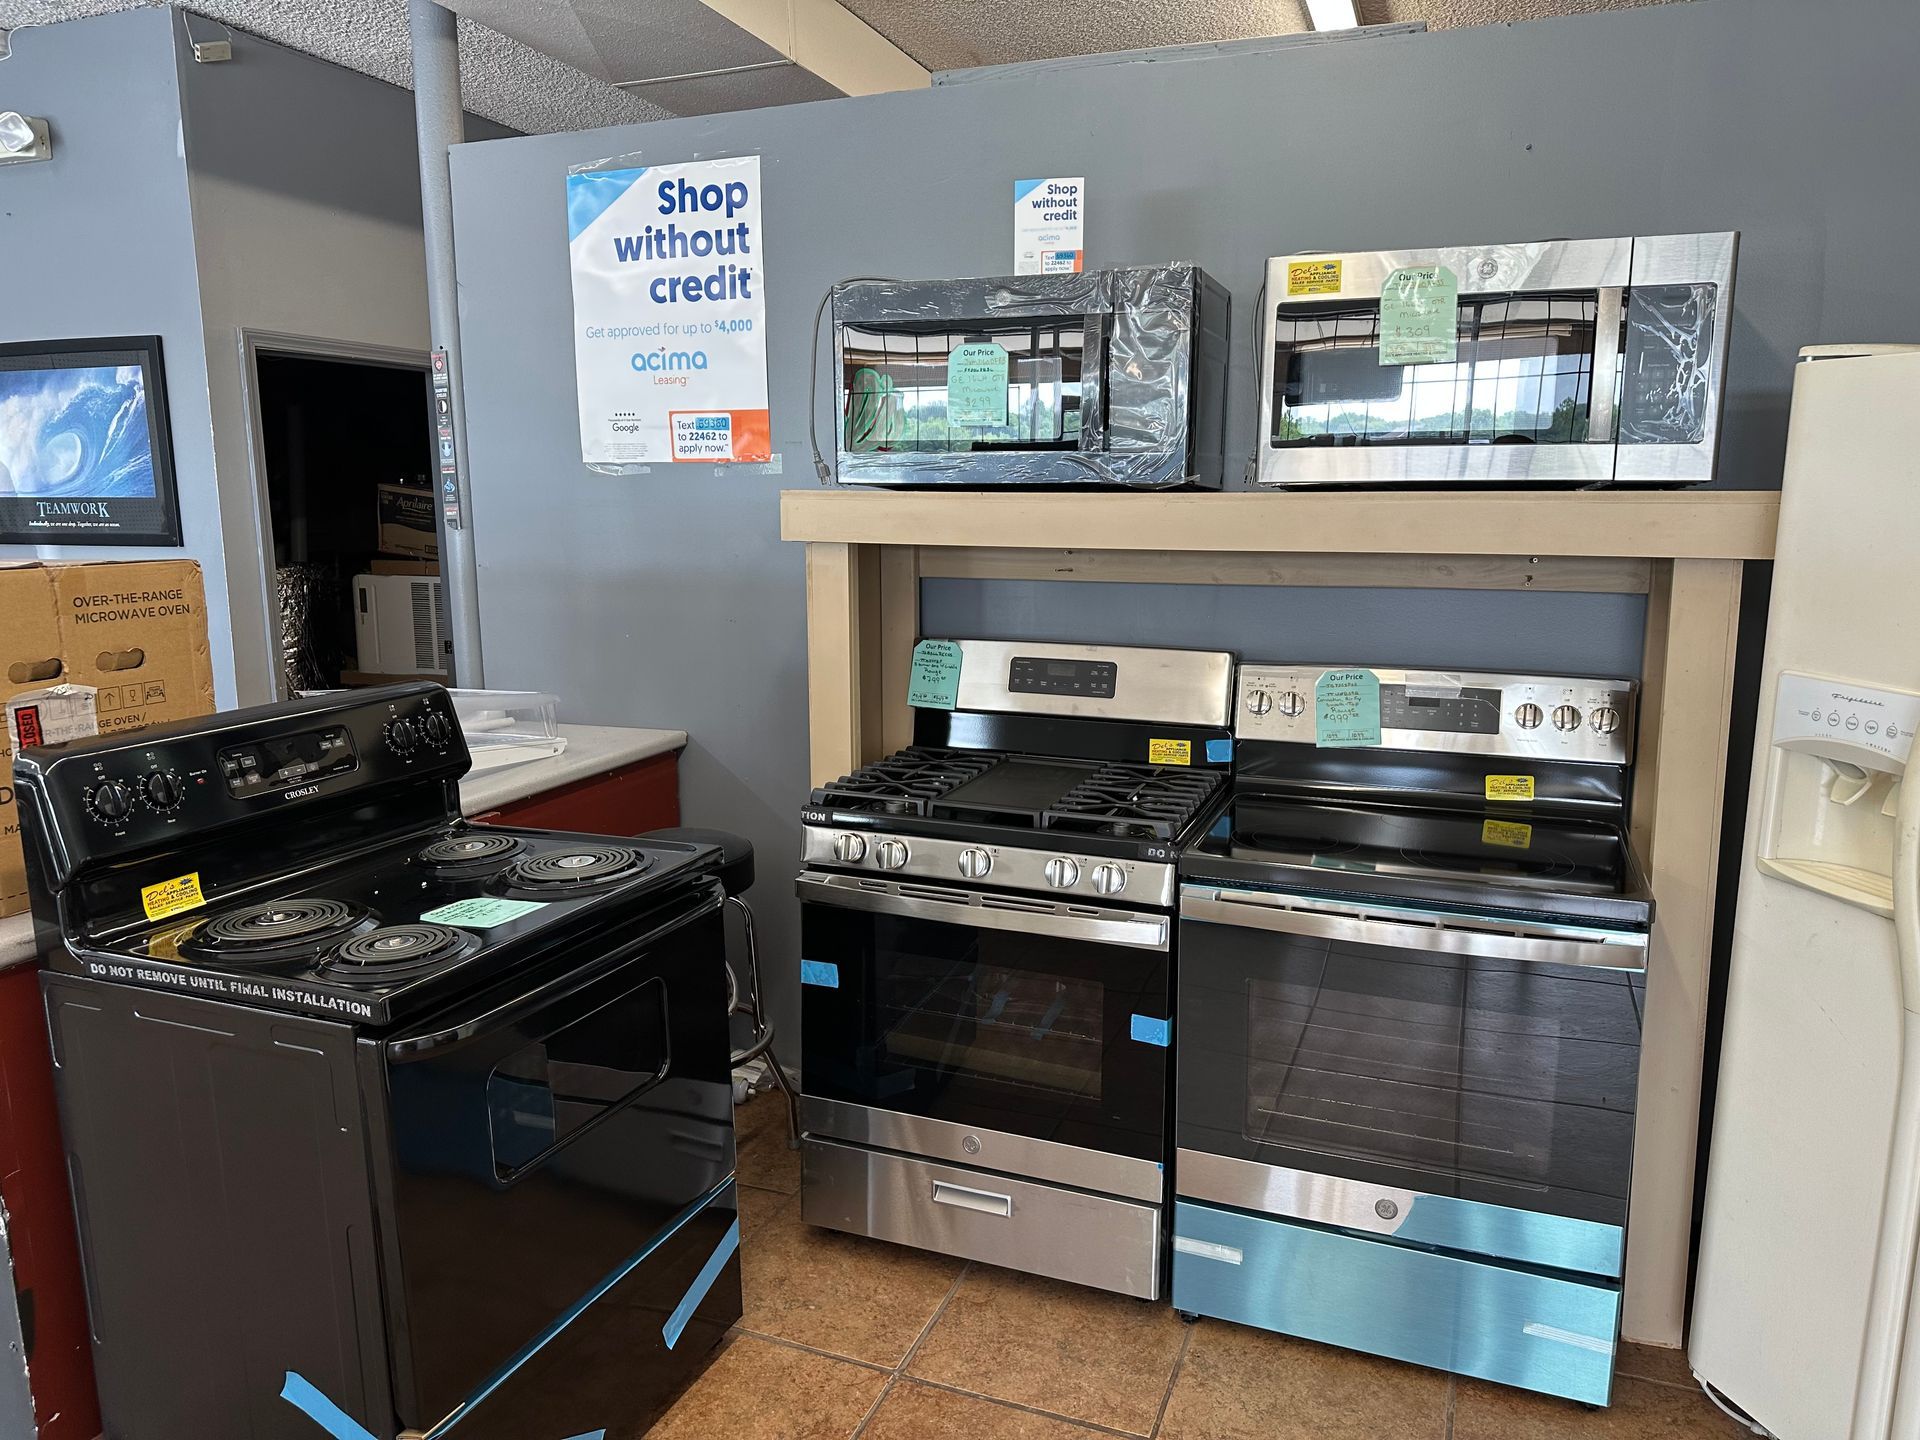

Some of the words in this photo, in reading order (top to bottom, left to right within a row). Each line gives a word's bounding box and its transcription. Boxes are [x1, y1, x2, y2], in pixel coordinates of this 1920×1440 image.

[1047, 184, 1078, 196] Shop
[658, 178, 748, 218] Shop
[1032, 197, 1078, 209] without
[1043, 209, 1078, 221] credit
[614, 222, 750, 262] without
[650, 264, 752, 303] credit
[586, 326, 605, 338] Get
[607, 322, 660, 340] approved
[663, 322, 679, 335] for
[682, 324, 698, 336] up
[700, 322, 712, 333] to
[714, 319, 753, 334] $4,000
[631, 347, 708, 371] acima
[653, 375, 688, 387] Leasing
[612, 423, 639, 433] Google
[677, 421, 695, 429] Text
[678, 433, 687, 441] to
[689, 432, 717, 441] 22462
[719, 433, 728, 441] to
[679, 444, 703, 454] apply
[36, 501, 110, 518] TEAMWORK
[73, 589, 183, 608] OVER-THE-RANGE
[75, 607, 156, 625] MICROWAVE
[158, 604, 190, 617] OVEN
[113, 715, 140, 727] OVEN
[284, 785, 320, 800] CROSLEY
[90, 963, 106, 975] DO
[109, 965, 134, 978] NOT
[137, 969, 187, 986] REMOVE
[190, 976, 227, 991] UNTIL
[230, 982, 268, 998] FINAL
[272, 987, 371, 1017] INSTALLATION
